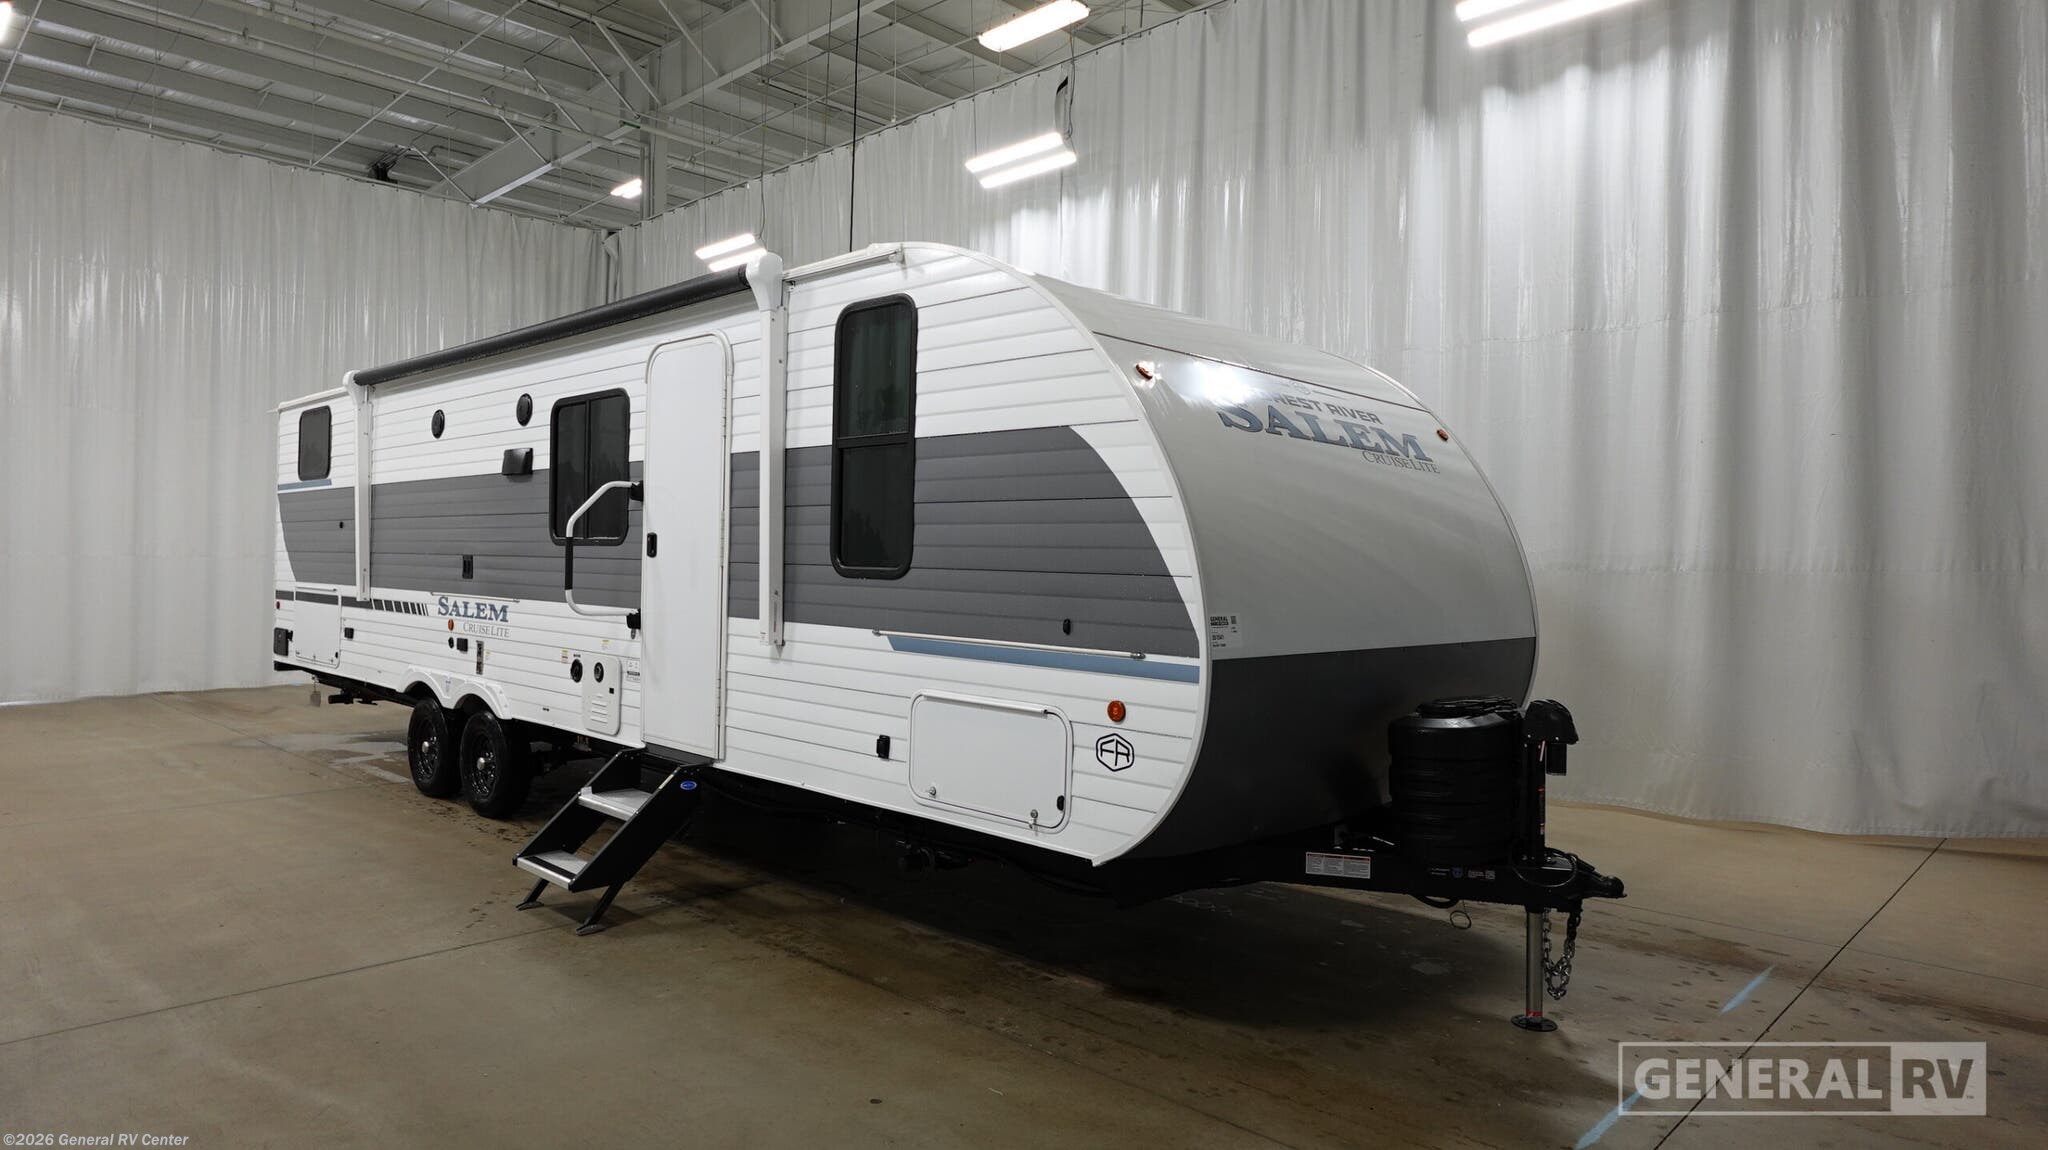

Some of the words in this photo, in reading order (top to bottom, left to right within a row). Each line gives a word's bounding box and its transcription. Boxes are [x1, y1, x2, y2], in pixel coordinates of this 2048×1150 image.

[1328, 403, 1384, 425] RIVER
[1216, 404, 1433, 462] SALEM
[437, 595, 509, 623] SALEM
